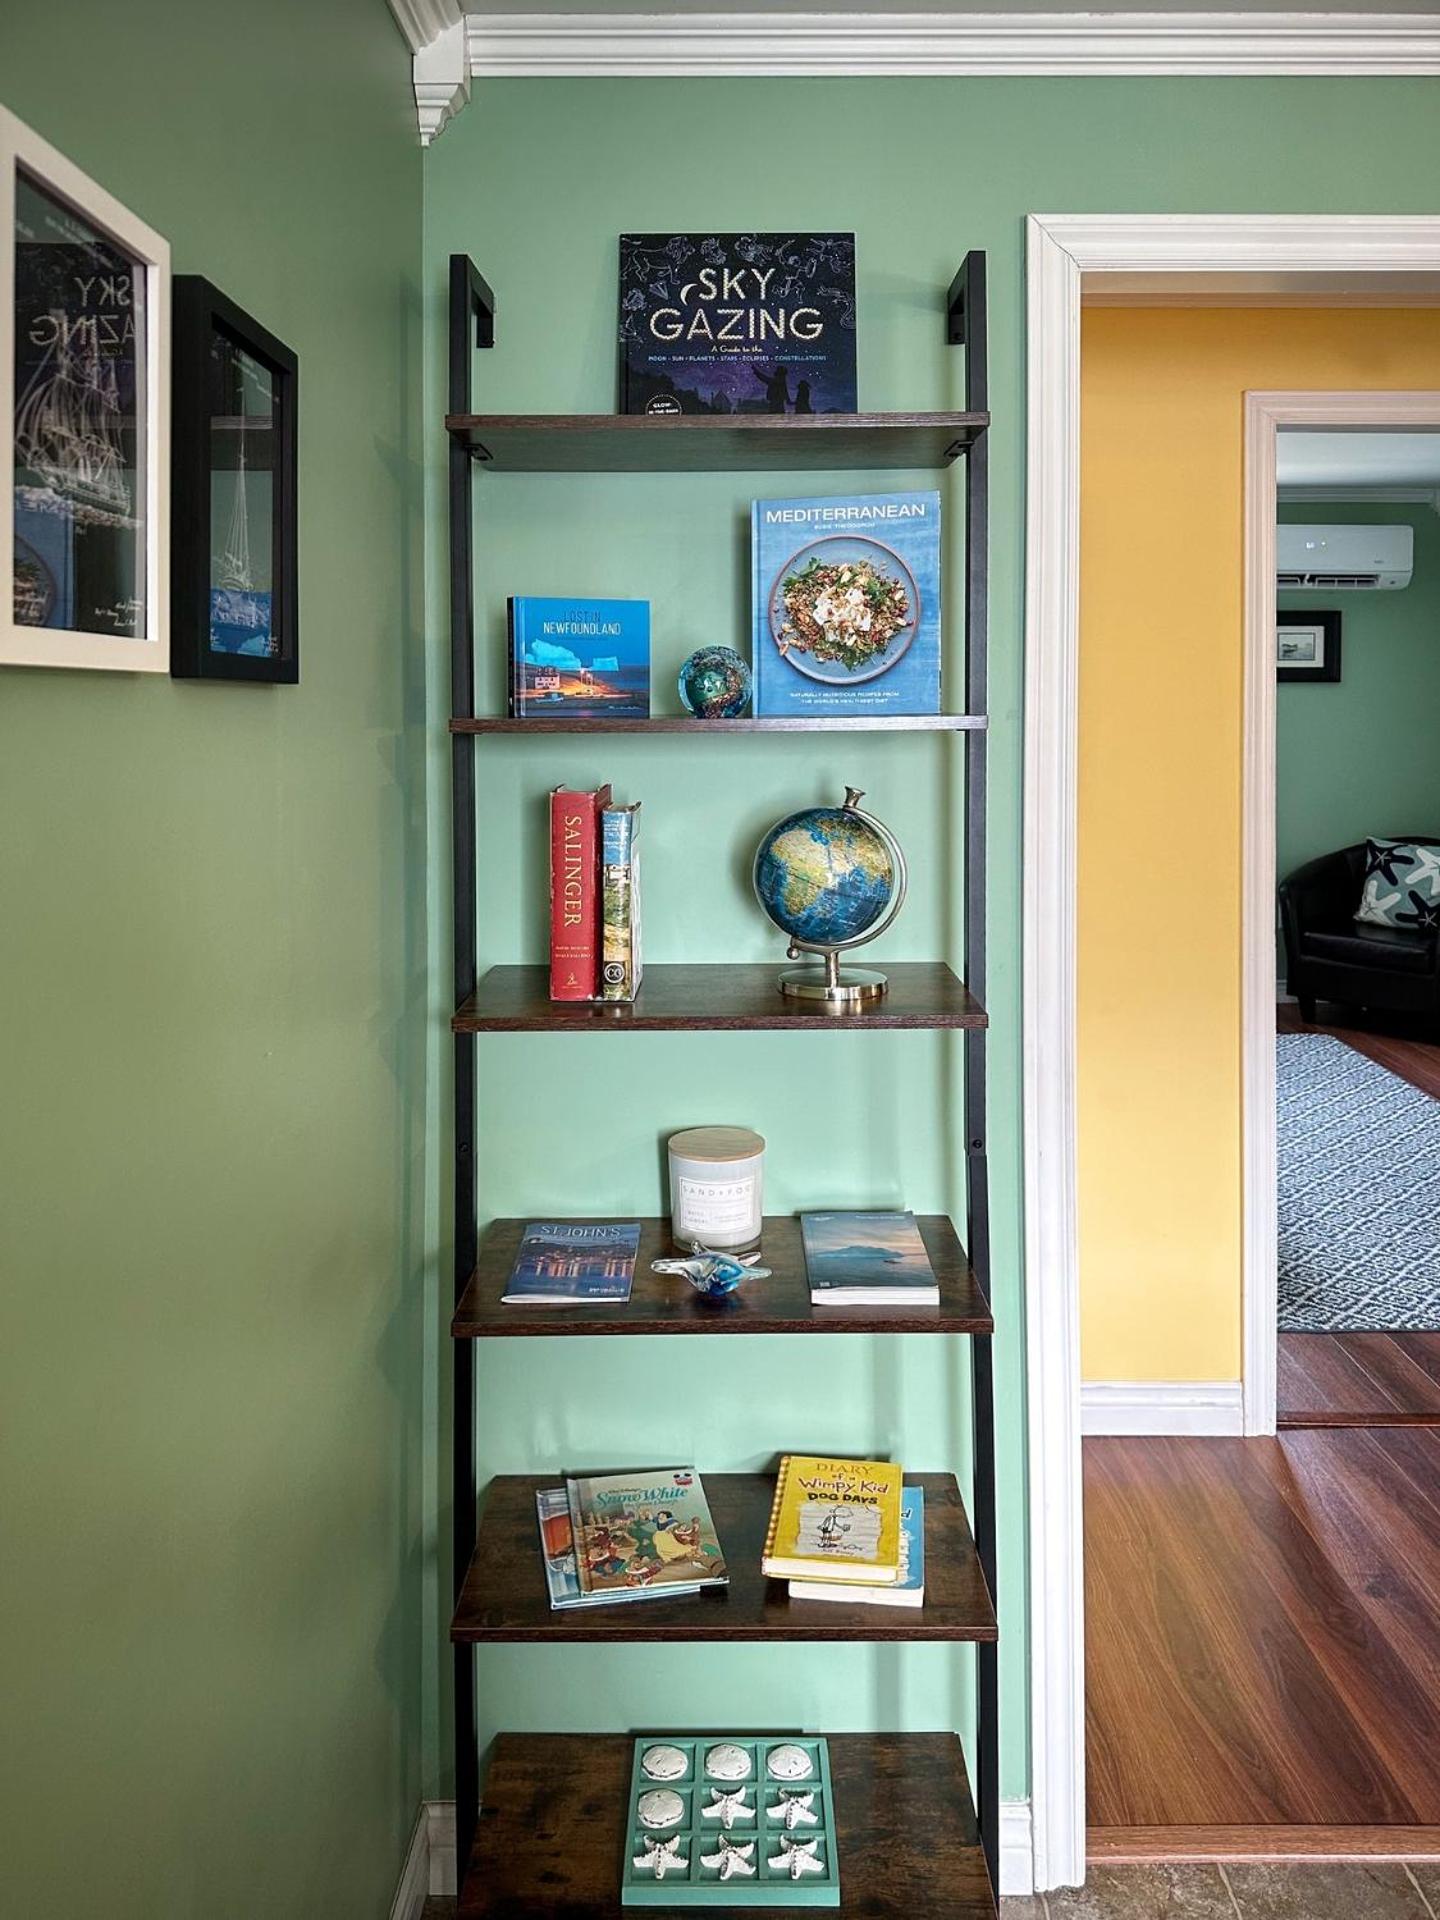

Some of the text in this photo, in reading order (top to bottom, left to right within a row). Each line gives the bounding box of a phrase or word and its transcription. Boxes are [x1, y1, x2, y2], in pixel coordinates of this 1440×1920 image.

[698, 267, 776, 301] SKY
[649, 307, 824, 341] GAZING
[766, 503, 926, 523] MEDITERRANEAN
[564, 610, 588, 622] LOST
[543, 621, 622, 636] NEWFOUNDLAND
[564, 815, 582, 927] SALINGER
[683, 1185, 716, 1197] SAND
[567, 1228, 621, 1238] JOHNS
[816, 1463, 874, 1475] DIARY
[832, 1472, 844, 1480] of
[798, 1477, 889, 1493] Wimpy Kid
[641, 1486, 689, 1501] White
[808, 1492, 878, 1505] DOG DAYS
